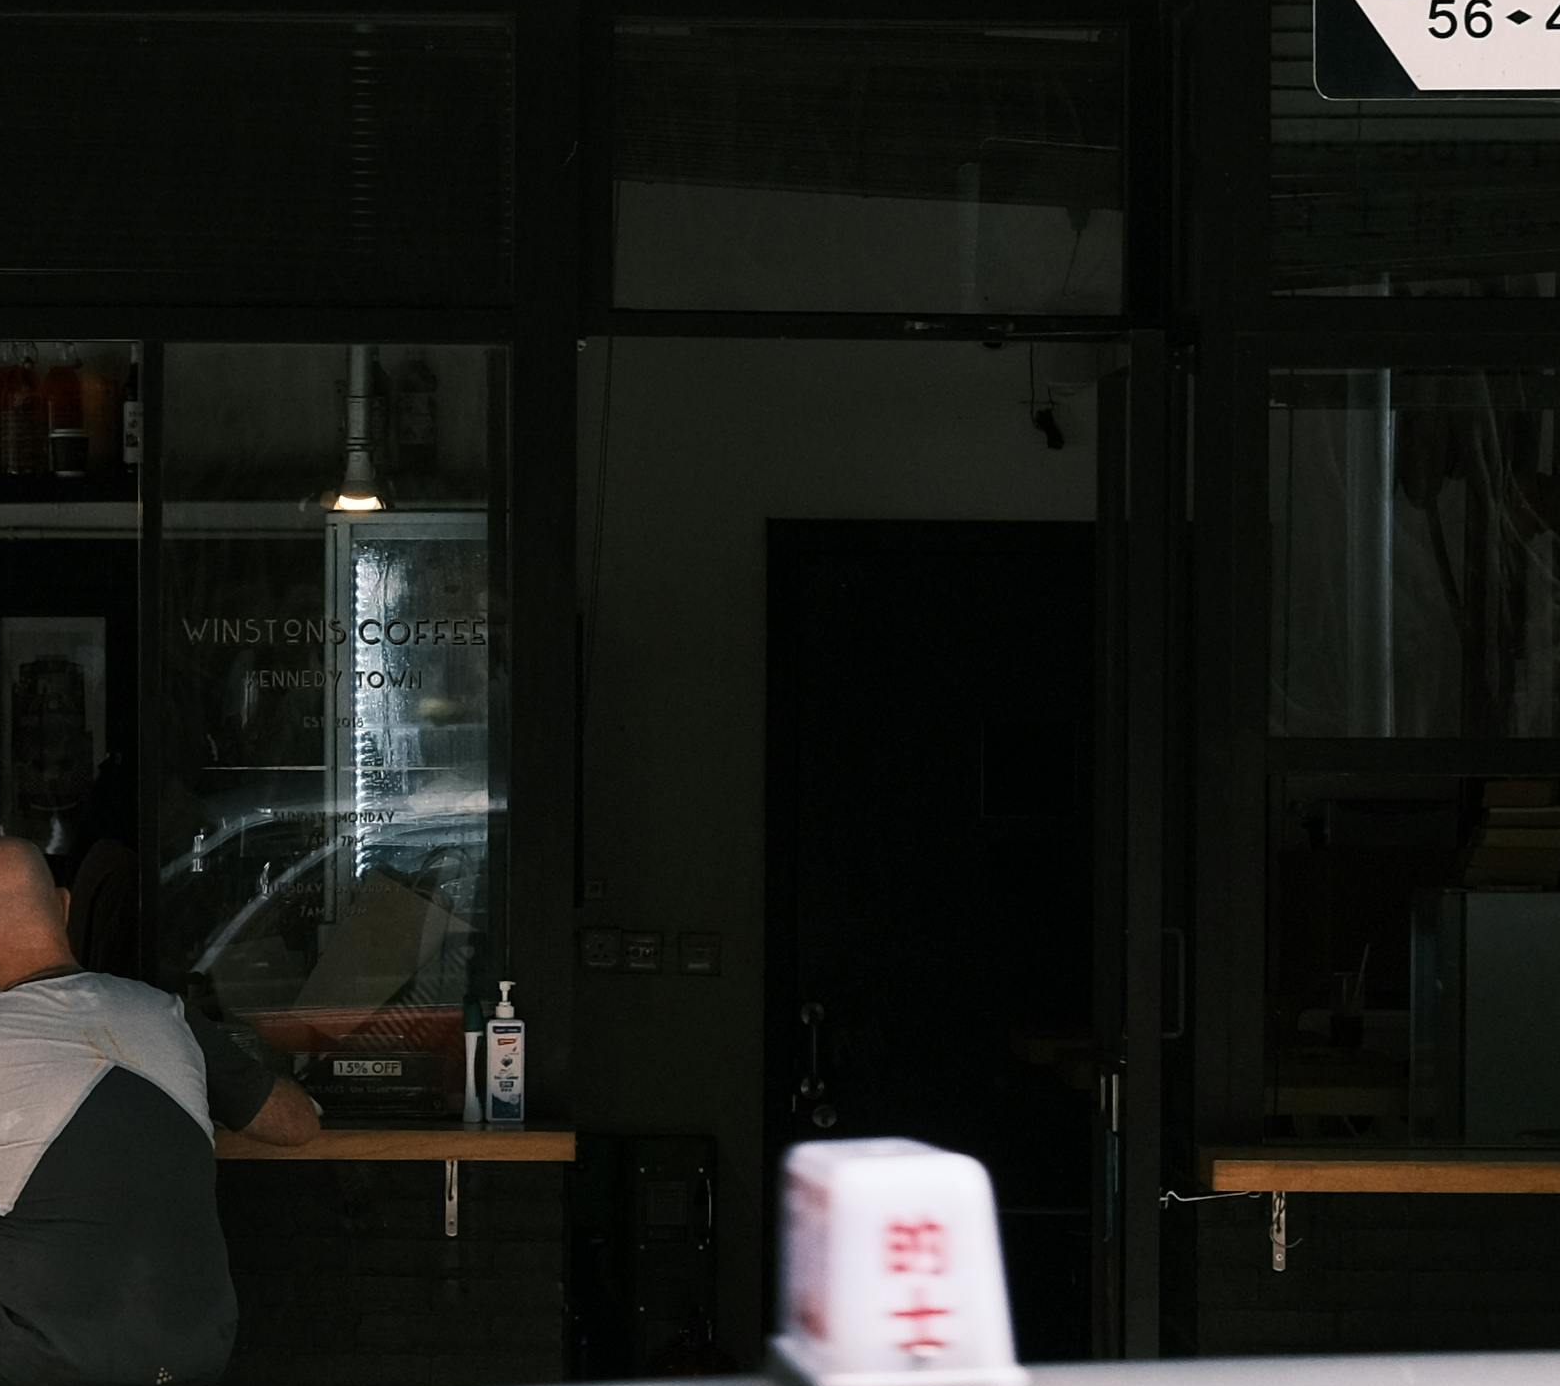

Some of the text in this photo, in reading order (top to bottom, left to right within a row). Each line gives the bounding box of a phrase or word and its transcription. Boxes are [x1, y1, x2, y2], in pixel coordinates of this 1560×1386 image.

[182, 618, 487, 645] WINSTONS COFFEE
[245, 669, 423, 690] KENNEDY TOWN
[336, 810, 395, 824] MONDAY
[337, 1062, 400, 1074] 15% OFF
